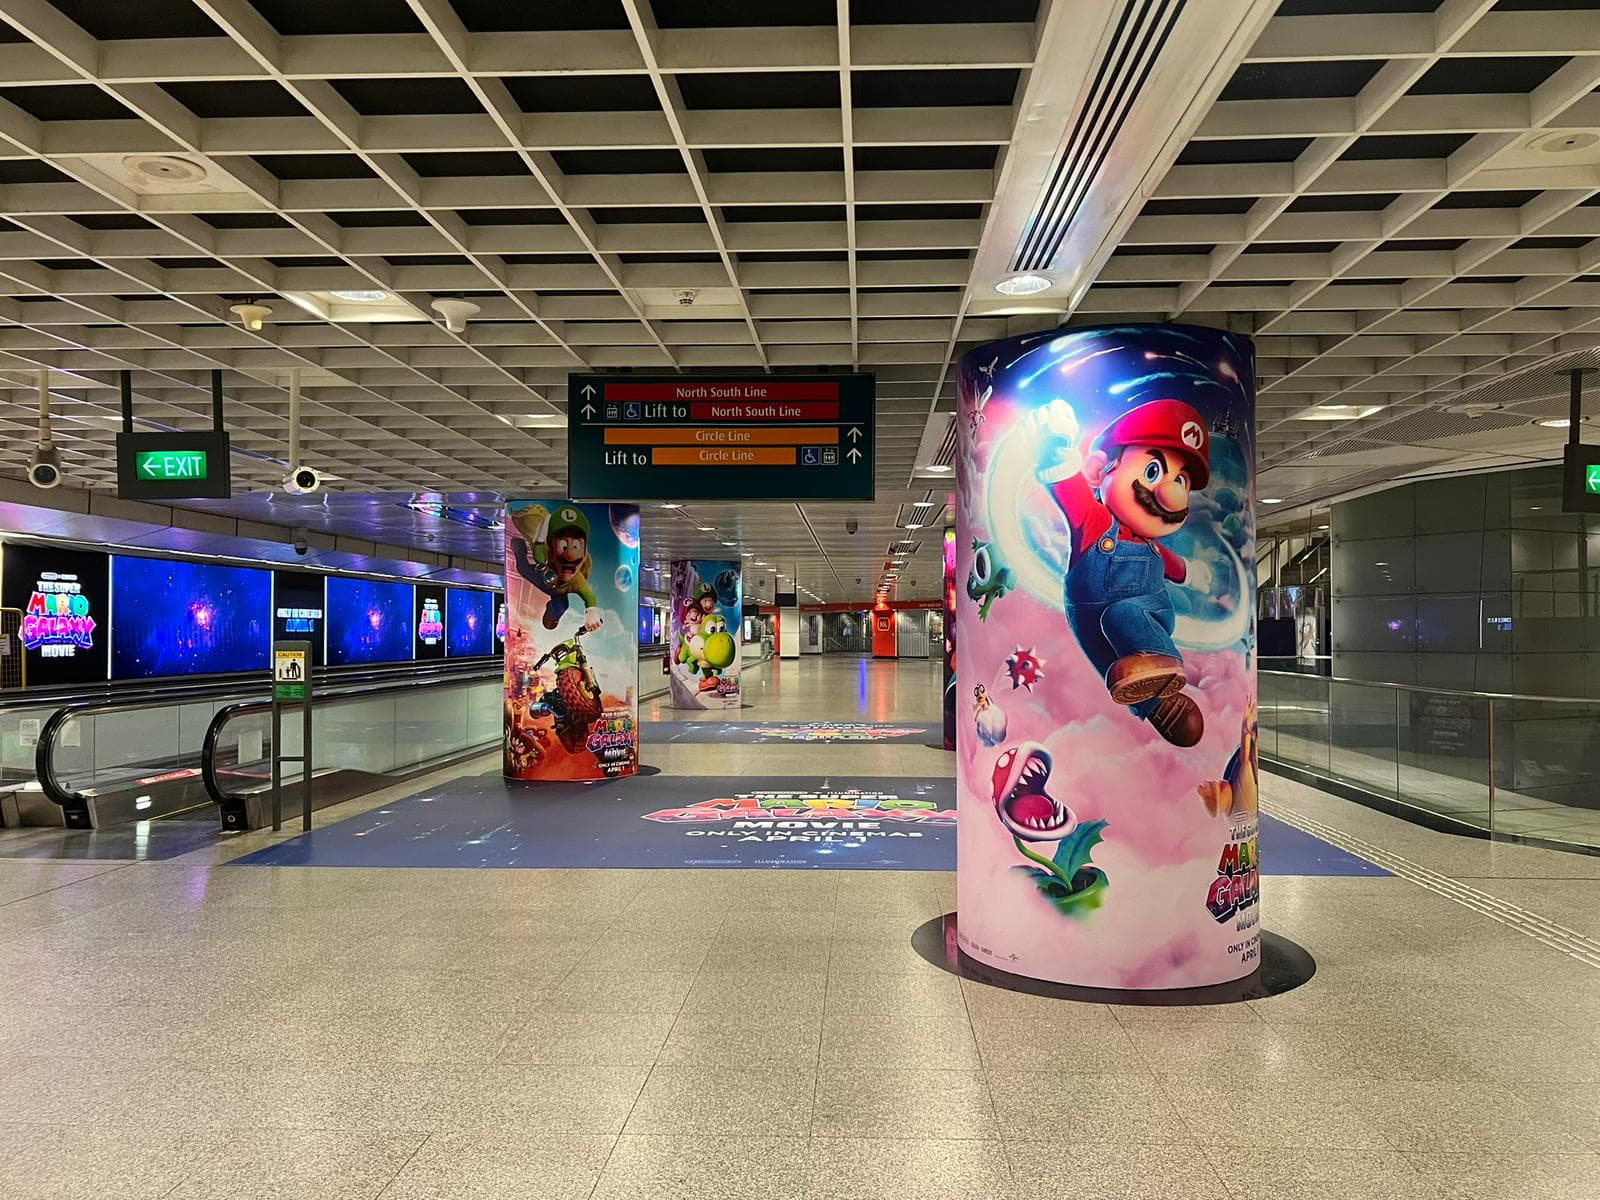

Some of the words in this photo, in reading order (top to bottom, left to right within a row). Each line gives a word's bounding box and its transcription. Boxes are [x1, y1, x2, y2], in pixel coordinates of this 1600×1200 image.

[676, 386, 707, 398] North
[711, 386, 741, 398] South
[744, 386, 768, 398] Line
[645, 403, 668, 418] Lift
[672, 405, 687, 418] to
[711, 406, 742, 417] North
[745, 406, 776, 417] South
[779, 406, 801, 417] Line
[695, 430, 725, 442] Circle
[728, 430, 751, 442] Line
[1184, 425, 1200, 447] M
[605, 450, 628, 465] Lift
[632, 452, 647, 466] to
[699, 449, 728, 461] Circle
[731, 449, 754, 461] Line
[164, 456, 202, 477] EXIT
[27, 591, 89, 617] MARIO
[18, 615, 97, 650] GALAXY
[41, 644, 76, 657] MOVIE
[686, 798, 938, 810] MARIO
[641, 807, 958, 825] GALAXY
[732, 821, 881, 830] MOVIE
[1217, 837, 1258, 873] MAR
[1228, 941, 1244, 954] ONLY
[1241, 946, 1257, 963] APRIL
